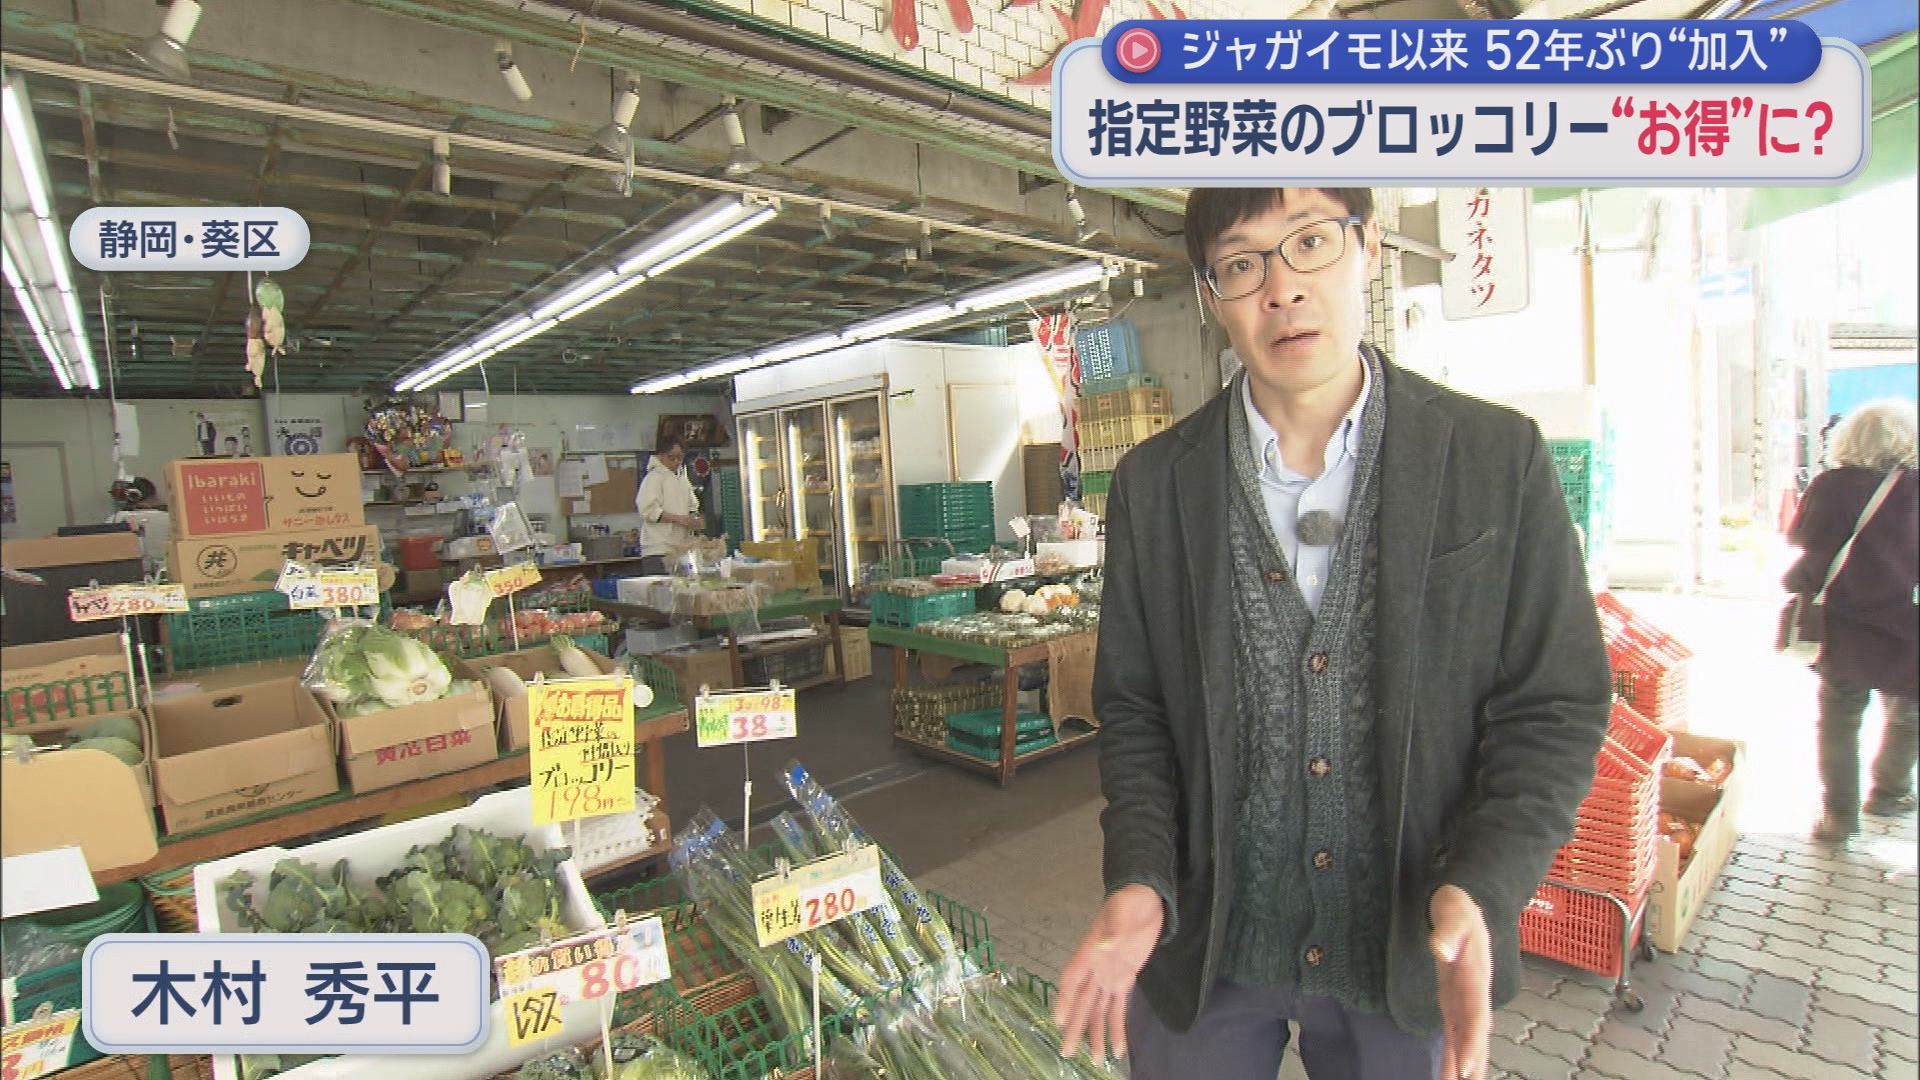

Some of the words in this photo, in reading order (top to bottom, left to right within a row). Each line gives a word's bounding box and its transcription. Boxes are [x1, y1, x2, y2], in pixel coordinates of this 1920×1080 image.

[1466, 196, 1496, 308] カネタツ
[189, 472, 256, 489] Ibaraki
[281, 534, 366, 563] キャベツ
[113, 599, 155, 614] 280
[322, 586, 362, 605] 380
[732, 713, 769, 740] 38
[538, 758, 631, 789] ブロッコリー
[805, 888, 856, 927] 280
[581, 954, 641, 1001] 80
[513, 991, 563, 1041] レタス
